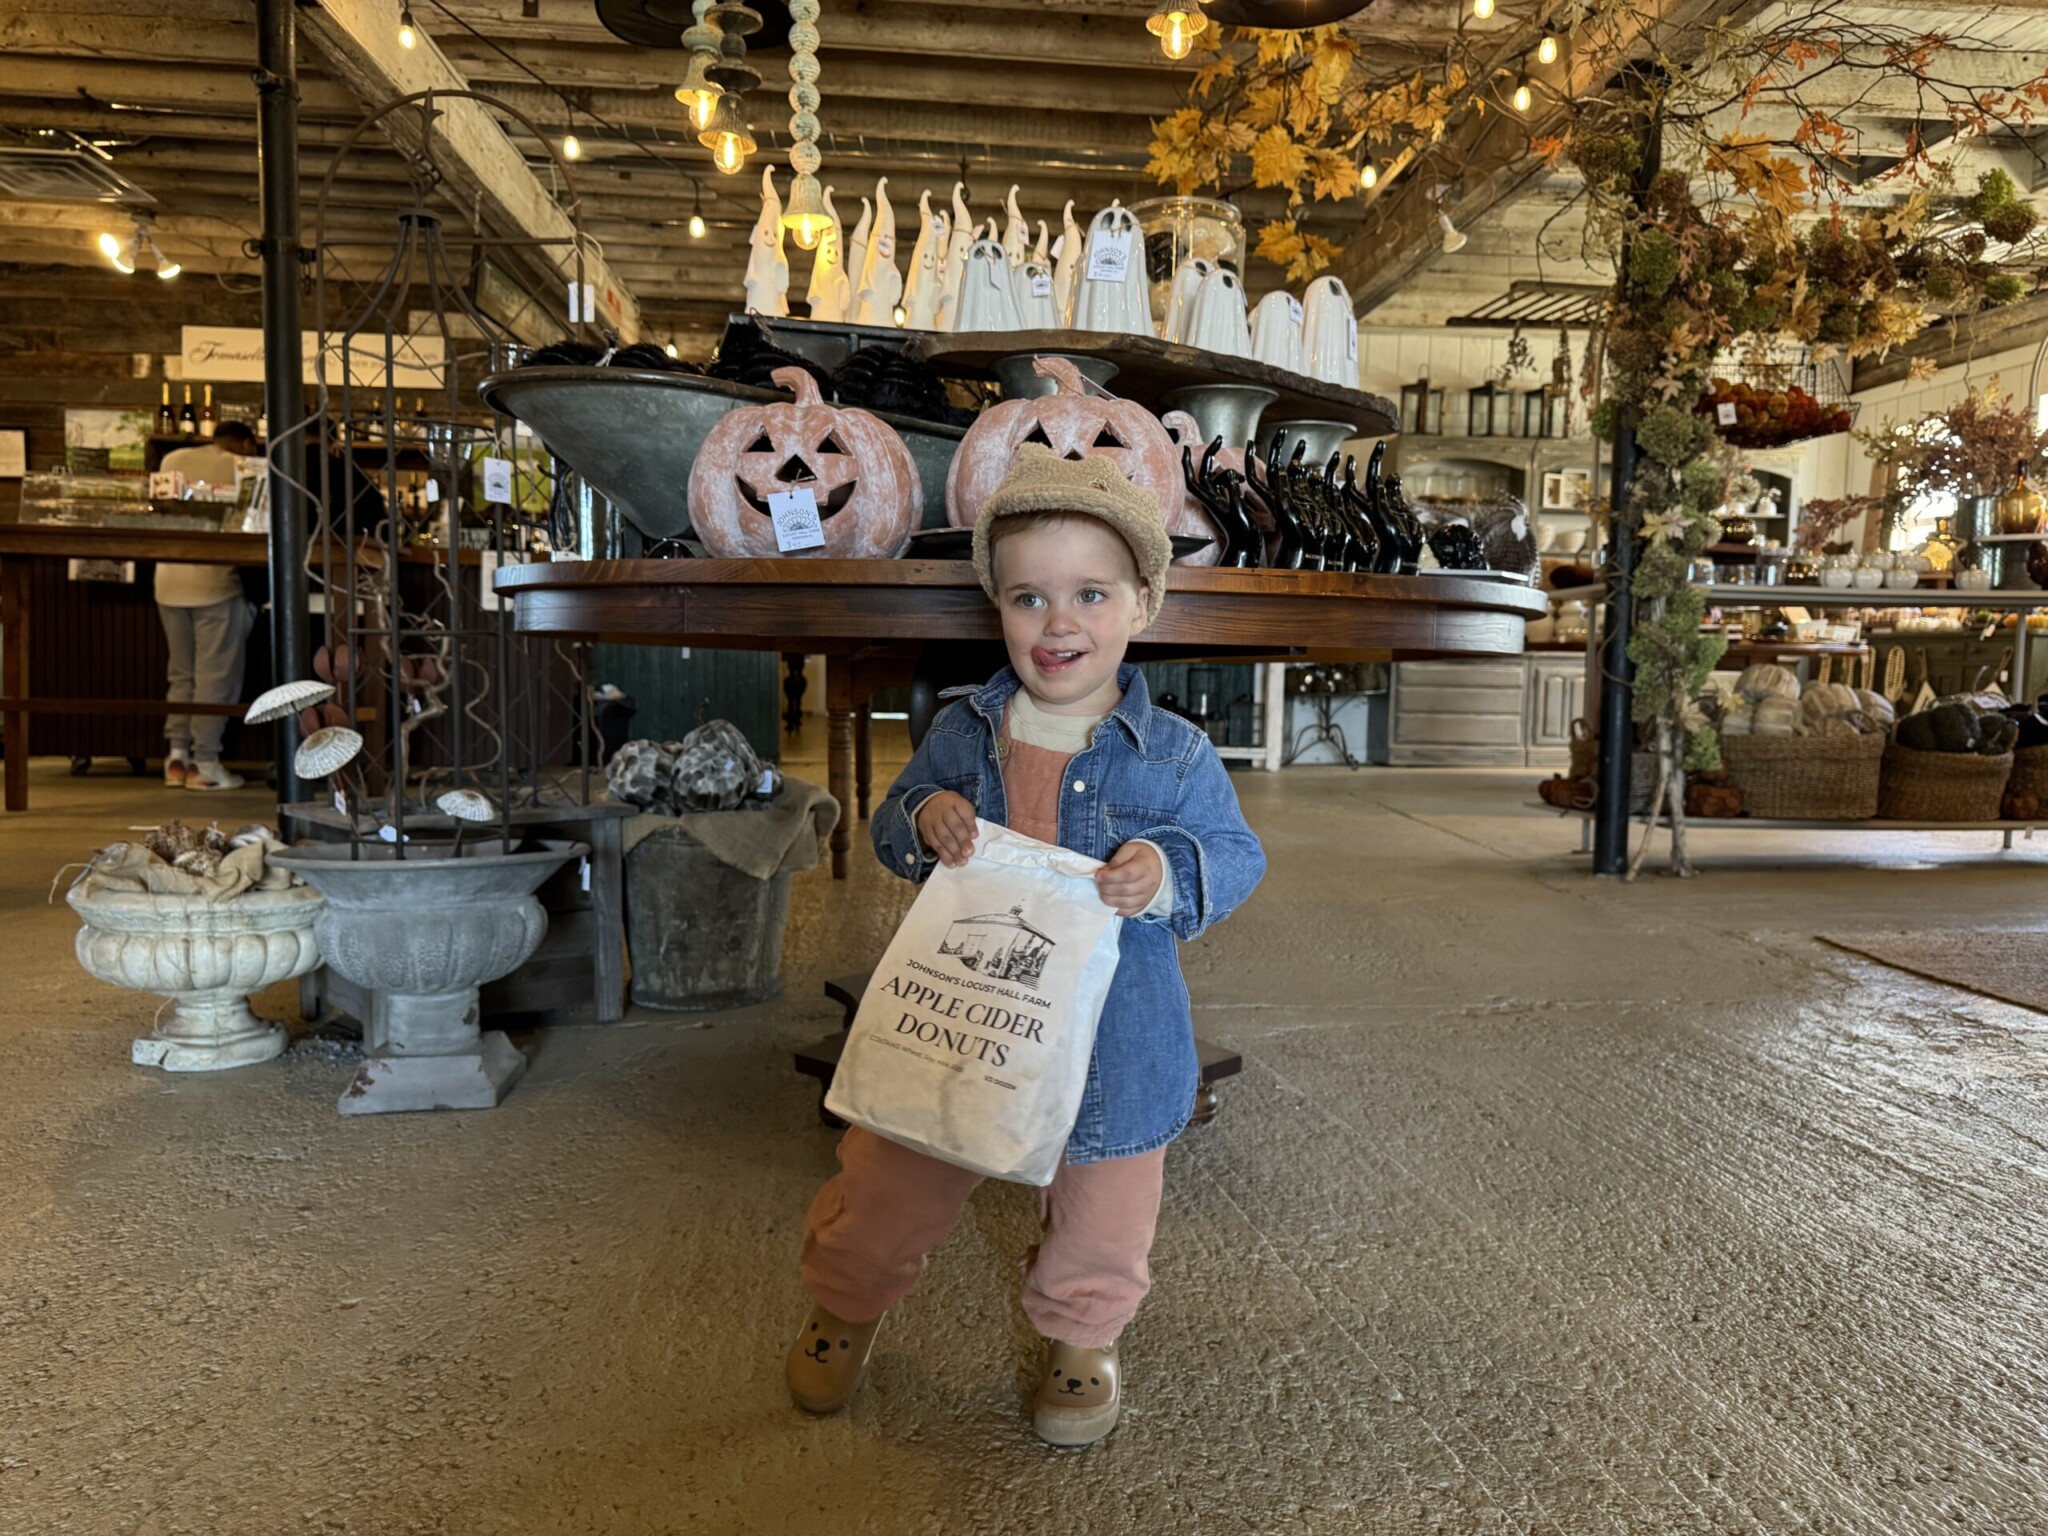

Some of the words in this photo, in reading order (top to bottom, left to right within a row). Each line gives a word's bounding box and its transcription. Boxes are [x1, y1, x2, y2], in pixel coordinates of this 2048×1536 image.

[776, 507, 818, 527] JOHNSON'S
[879, 975, 965, 1019] APPLE
[965, 1003, 1044, 1044] CIDER
[906, 959, 961, 985] JOHNSON'S
[961, 979, 997, 994] LOCUST
[996, 986, 1021, 1000] HALL
[1021, 994, 1052, 1009] FARM
[894, 1011, 1010, 1067] DONUTS
